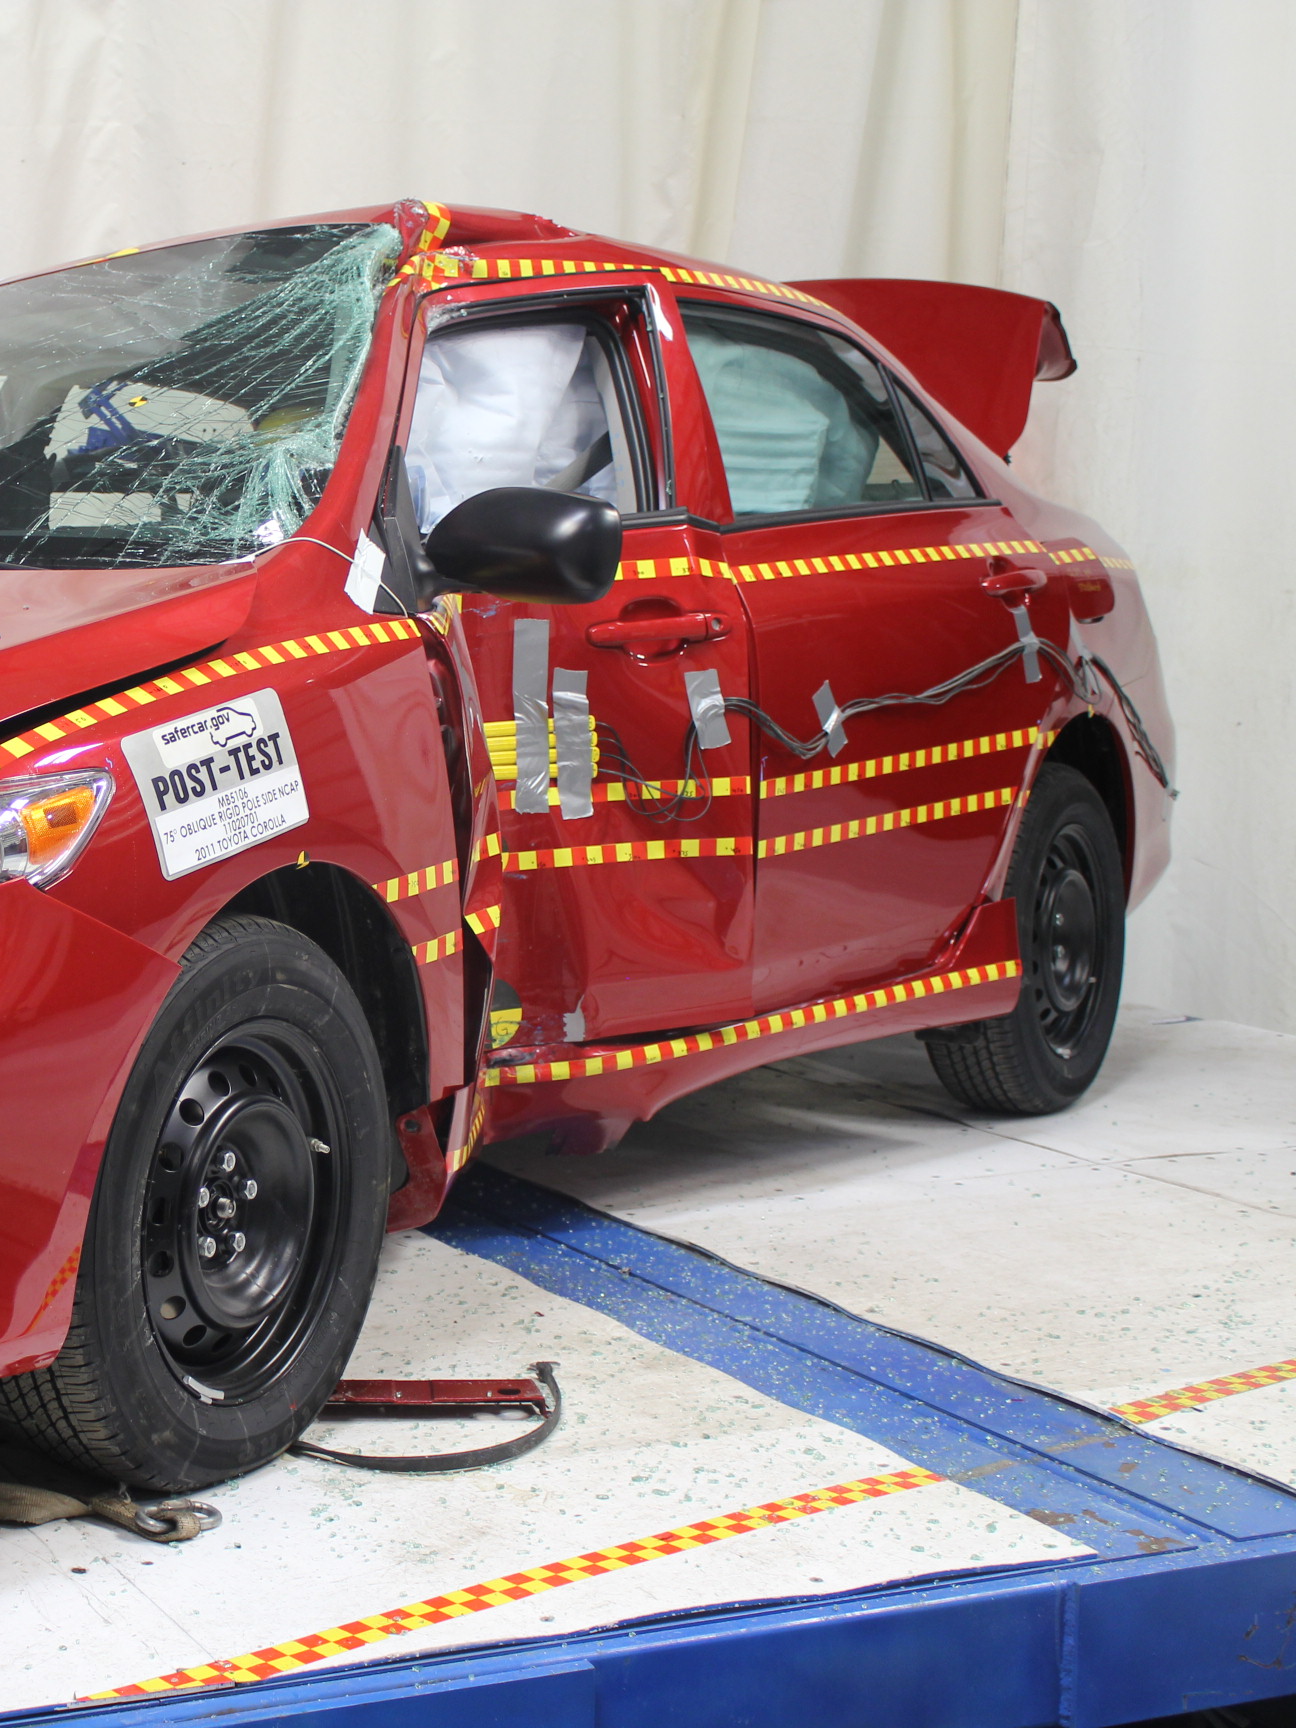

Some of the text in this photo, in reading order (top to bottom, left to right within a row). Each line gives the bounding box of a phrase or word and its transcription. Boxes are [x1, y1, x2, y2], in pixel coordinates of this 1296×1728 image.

[161, 711, 230, 746] safercar.gov
[151, 732, 284, 811] POST-TEST
[163, 780, 300, 845] 75° OBLIQUE RIGID POLE SIDE NCAP
[218, 788, 249, 809] MB5106
[194, 814, 287, 861] 2011 TOYOTA COROLLA
[223, 811, 259, 834] 11020701
